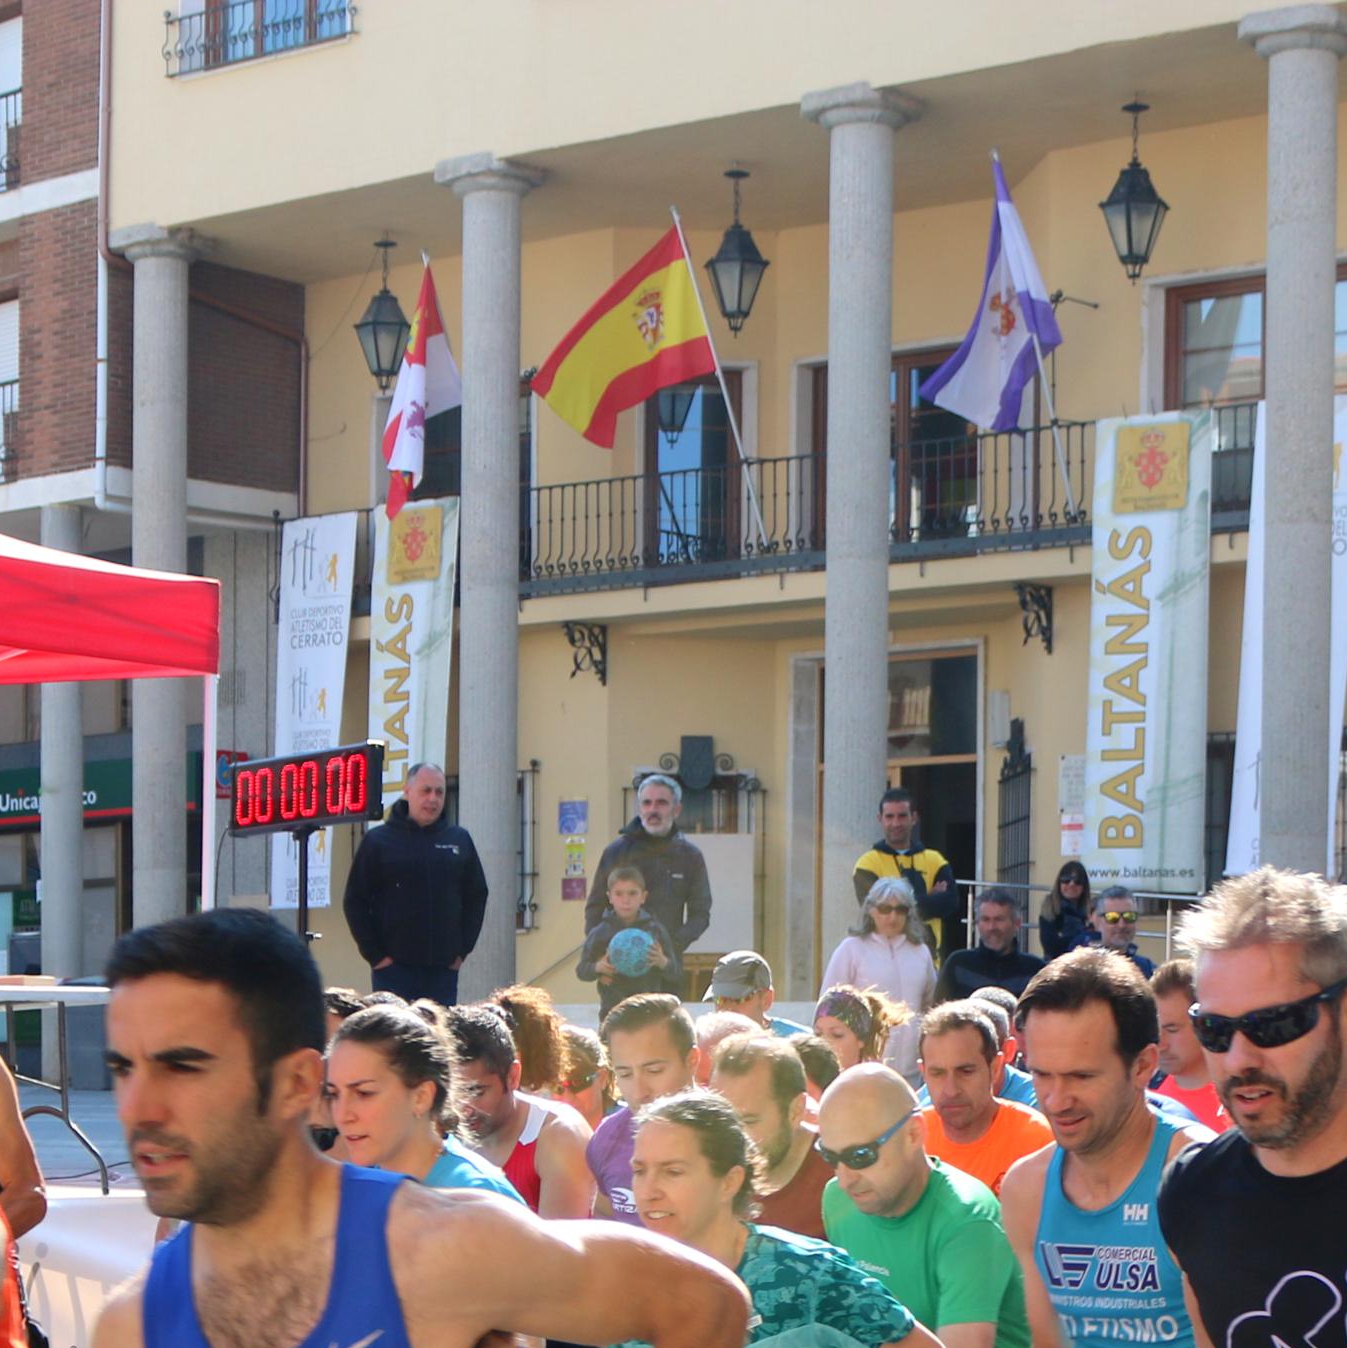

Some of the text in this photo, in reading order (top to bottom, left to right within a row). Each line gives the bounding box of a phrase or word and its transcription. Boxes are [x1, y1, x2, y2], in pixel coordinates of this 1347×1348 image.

[290, 605, 344, 619] CLUB DEPORTIVO
[291, 617, 344, 634] ATLETISMO DEL
[290, 631, 344, 649] CERRATO
[1094, 525, 1154, 849] BALTANÁS
[1086, 865, 1195, 880] www.baltanas.es
[1123, 1203, 1149, 1221] HH
[1097, 1246, 1158, 1262] COMERCIAL
[1096, 1261, 1162, 1292] ULSA
[1094, 1296, 1167, 1309] INDUSTRIALES
